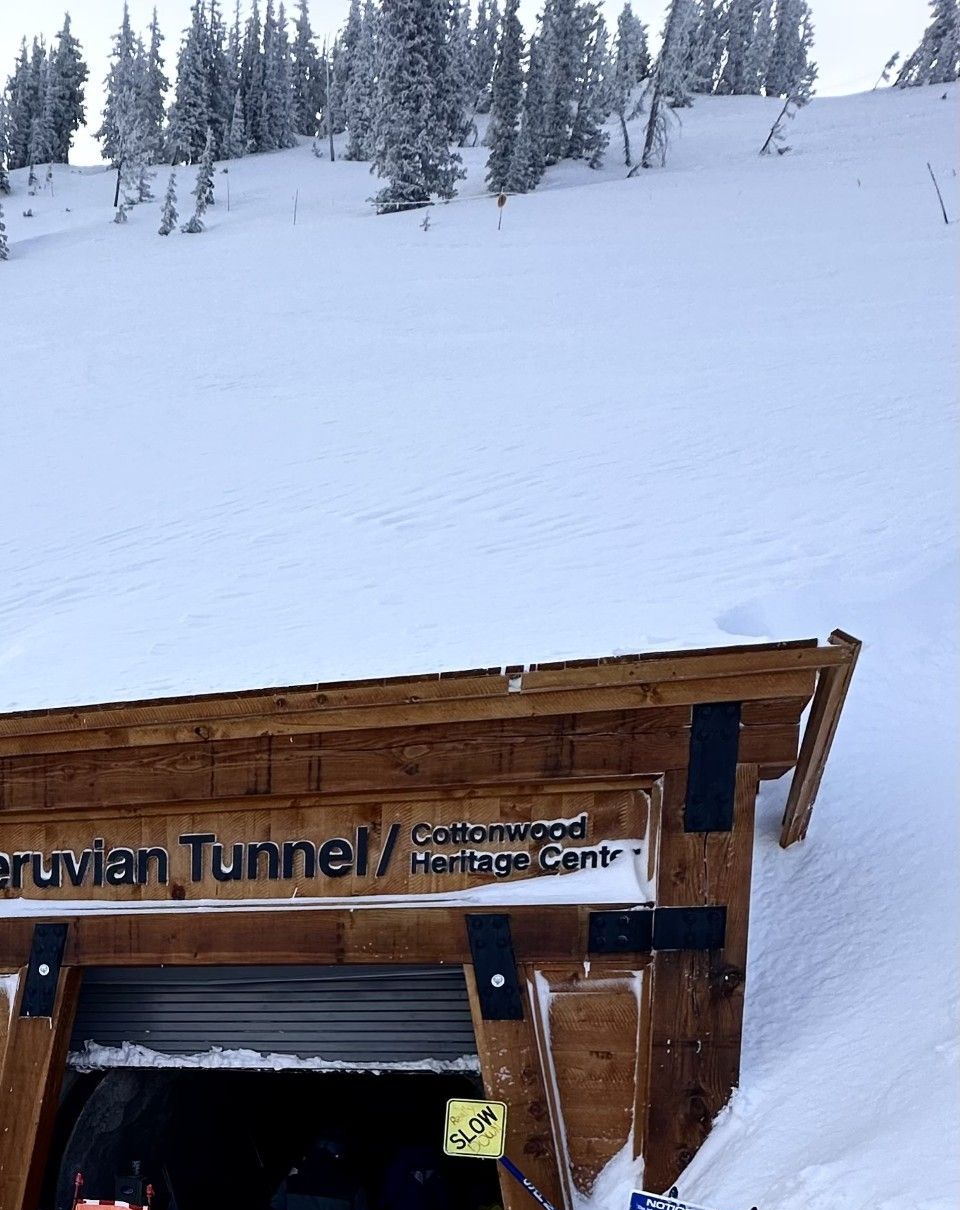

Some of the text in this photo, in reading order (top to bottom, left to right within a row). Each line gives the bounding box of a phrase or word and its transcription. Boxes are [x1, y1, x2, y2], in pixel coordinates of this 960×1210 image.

[411, 815, 587, 846] Cottonwood
[411, 844, 640, 877] Heritage Cent
[449, 1105, 498, 1149] SLOW
